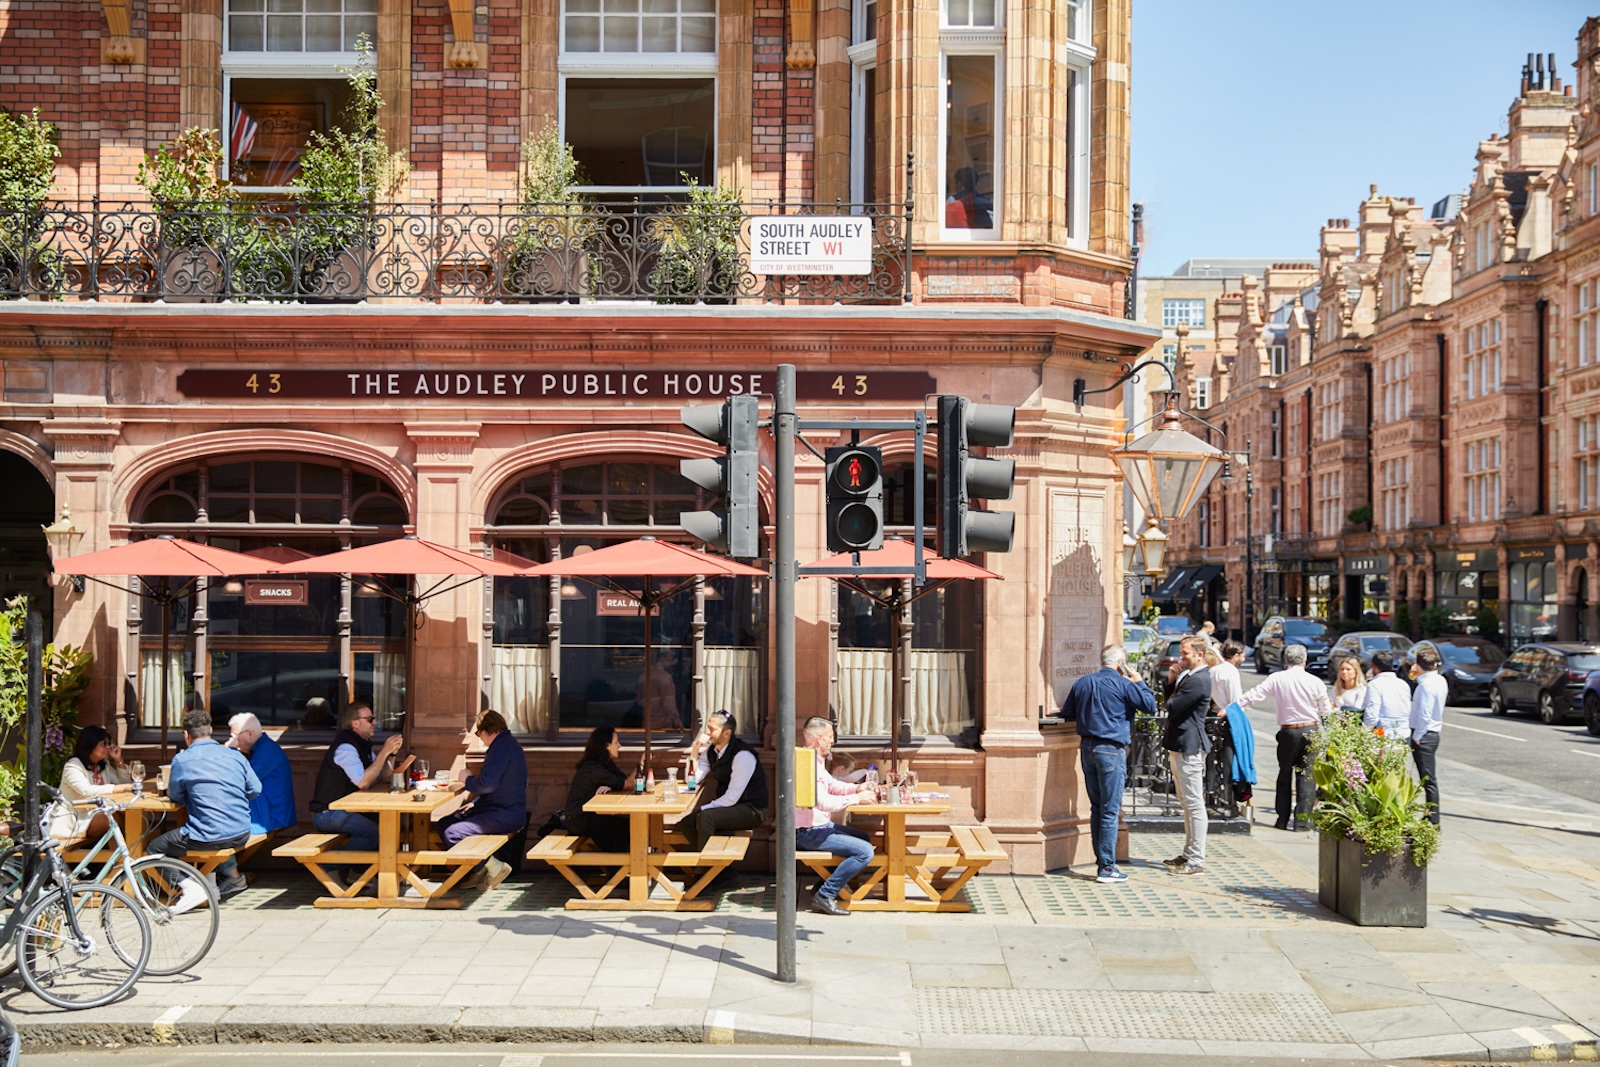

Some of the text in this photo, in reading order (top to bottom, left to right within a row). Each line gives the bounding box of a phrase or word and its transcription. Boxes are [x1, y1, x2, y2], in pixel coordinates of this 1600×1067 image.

[760, 223, 863, 238] SOUTH AUDLEY
[760, 241, 843, 256] STREET W1
[760, 264, 834, 272] CITY OF WESTMINSTER
[347, 373, 764, 396] THE AUDLEY PUBLIC HOUSE
[1056, 561, 1098, 577] PUBLIC
[259, 588, 292, 597] SNACKS
[1056, 579, 1098, 595] HOUSE
[606, 599, 627, 607] REAL
